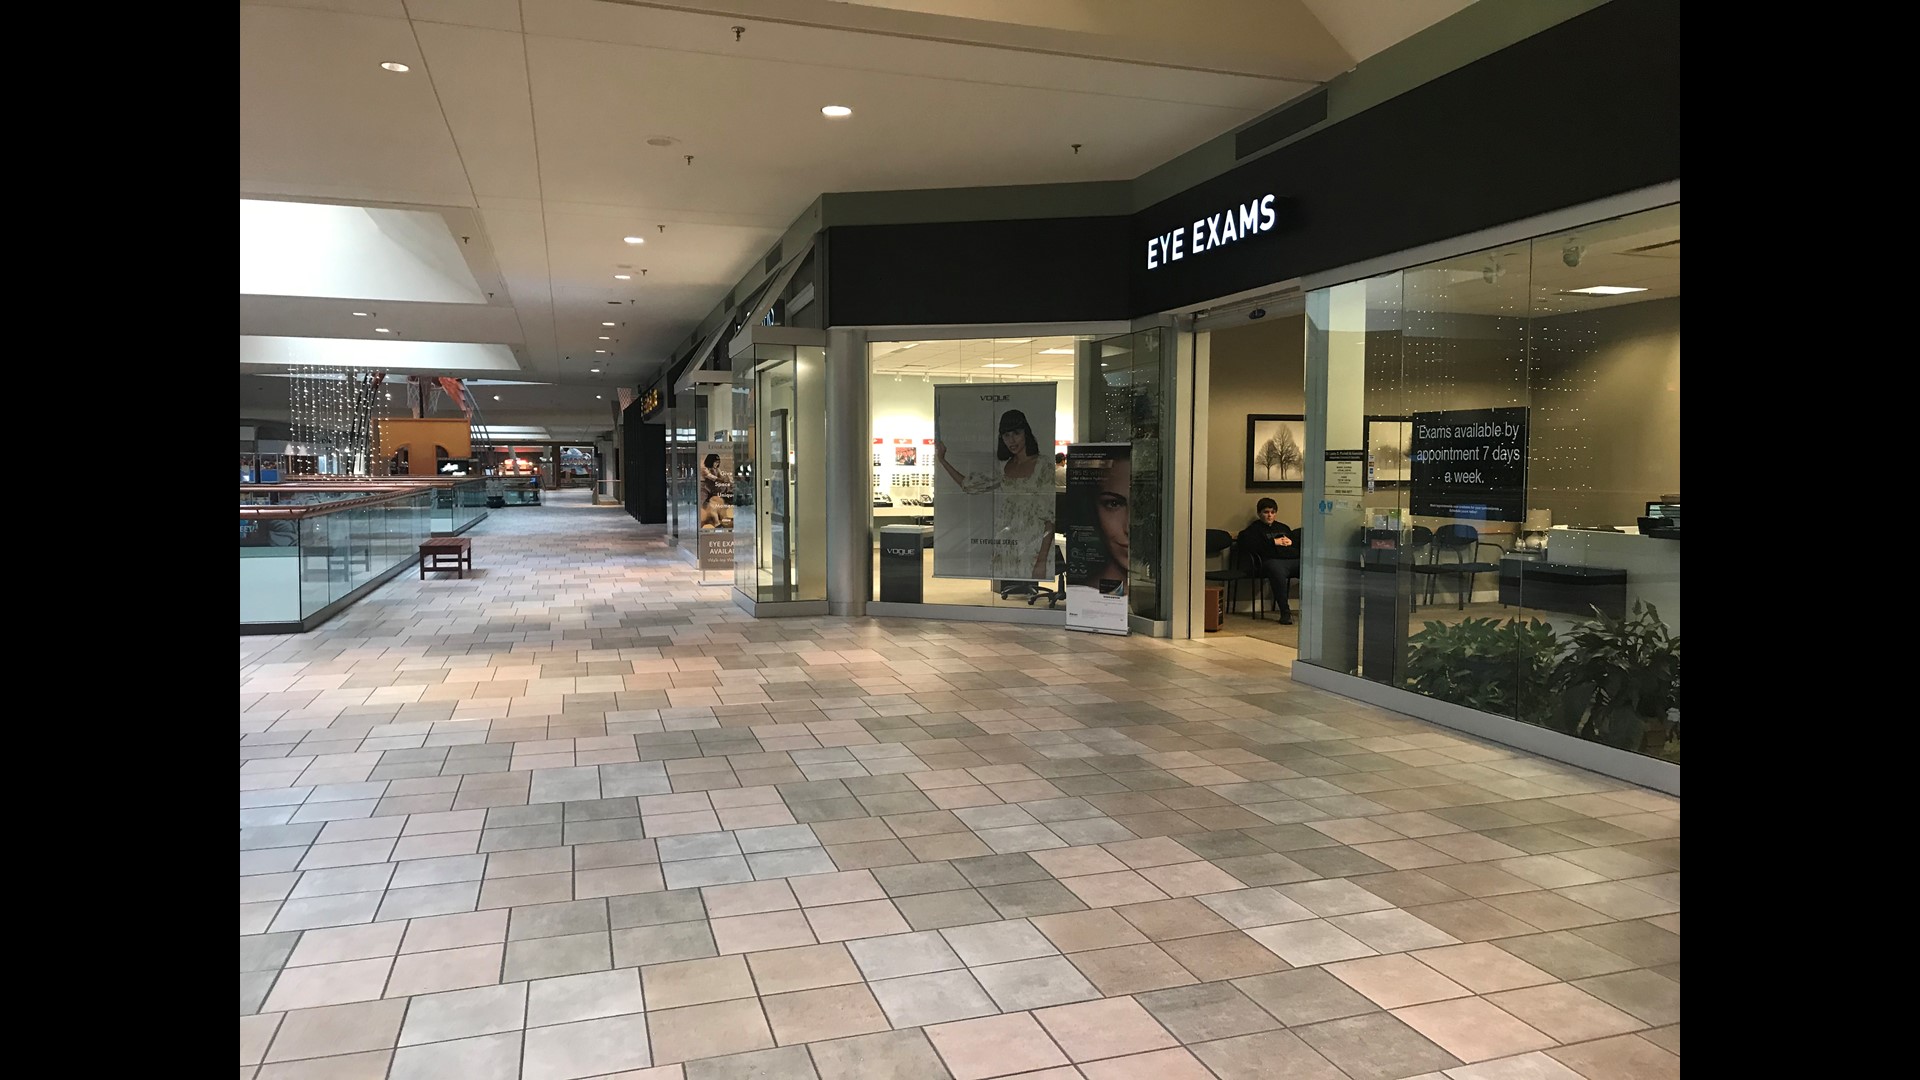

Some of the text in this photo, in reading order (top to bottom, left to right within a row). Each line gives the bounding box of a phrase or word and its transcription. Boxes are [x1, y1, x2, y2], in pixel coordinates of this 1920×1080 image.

[1147, 194, 1276, 270] EYE EXAMS
[980, 394, 1010, 402] VOGUE
[1419, 421, 1520, 440] Exams available by
[1416, 445, 1520, 464] appointment 7 days
[1444, 469, 1485, 484] a week.
[709, 540, 735, 548] EYE EXA
[886, 547, 916, 556] VOGUE
